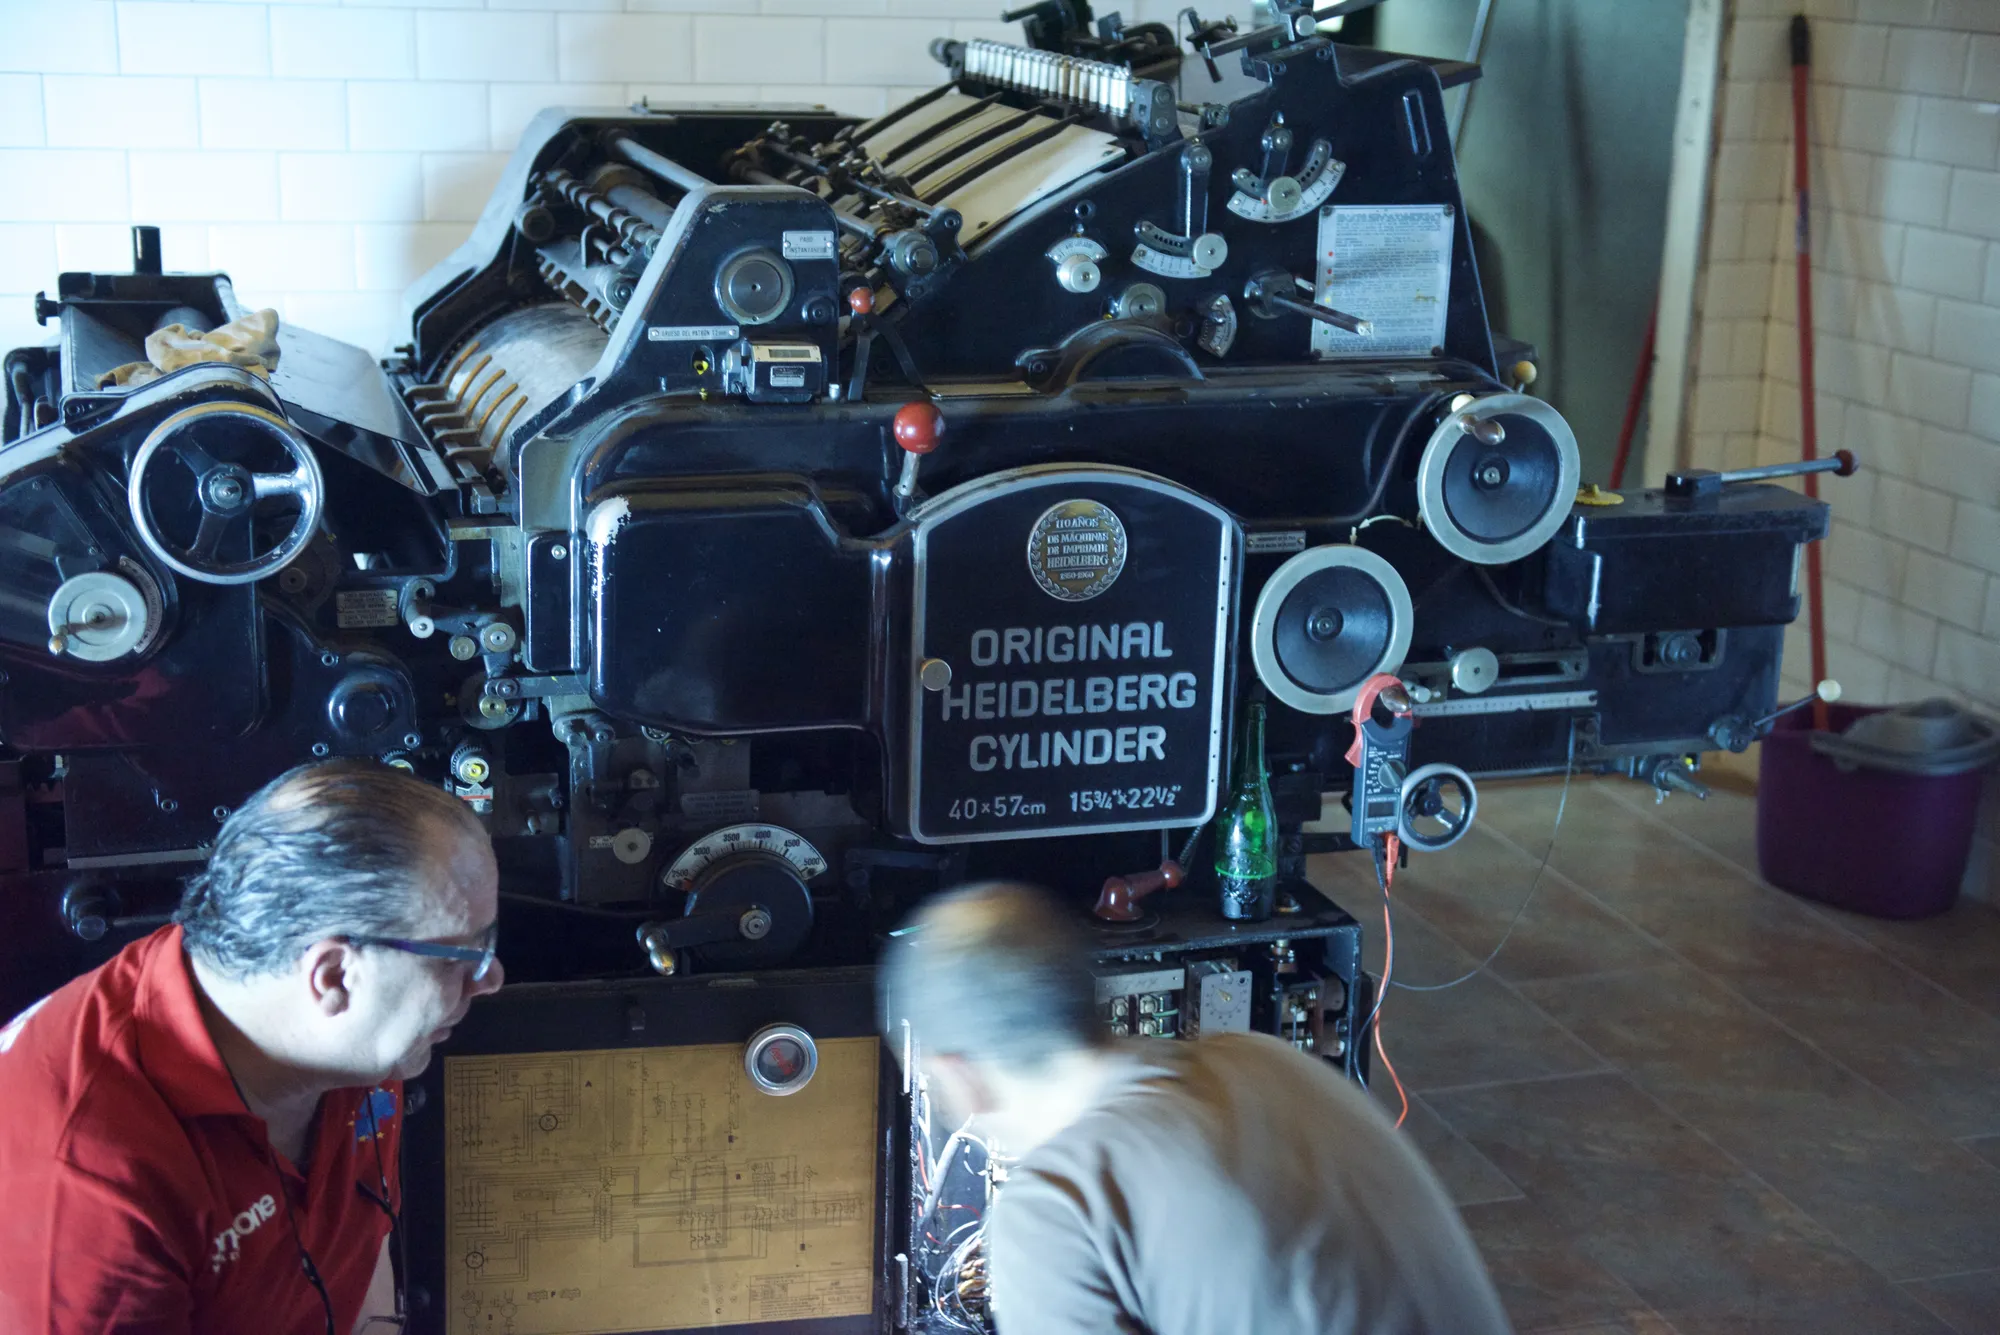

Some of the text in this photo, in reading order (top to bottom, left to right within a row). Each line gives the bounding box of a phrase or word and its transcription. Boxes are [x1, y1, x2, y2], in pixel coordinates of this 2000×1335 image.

[1071, 516, 1099, 528] AÑOS
[1047, 534, 1060, 544] DE
[1047, 543, 1108, 555] DE IMPRIMIR
[1047, 554, 1109, 568] HEIDELBERG
[970, 621, 1173, 667] ORIGINAL
[941, 671, 1197, 721] HEIDELBERG
[969, 725, 1167, 772] CYLINDER
[723, 833, 740, 842] 3500
[754, 830, 771, 840] 4000
[784, 839, 801, 848] 4500
[803, 857, 820, 866] 5000
